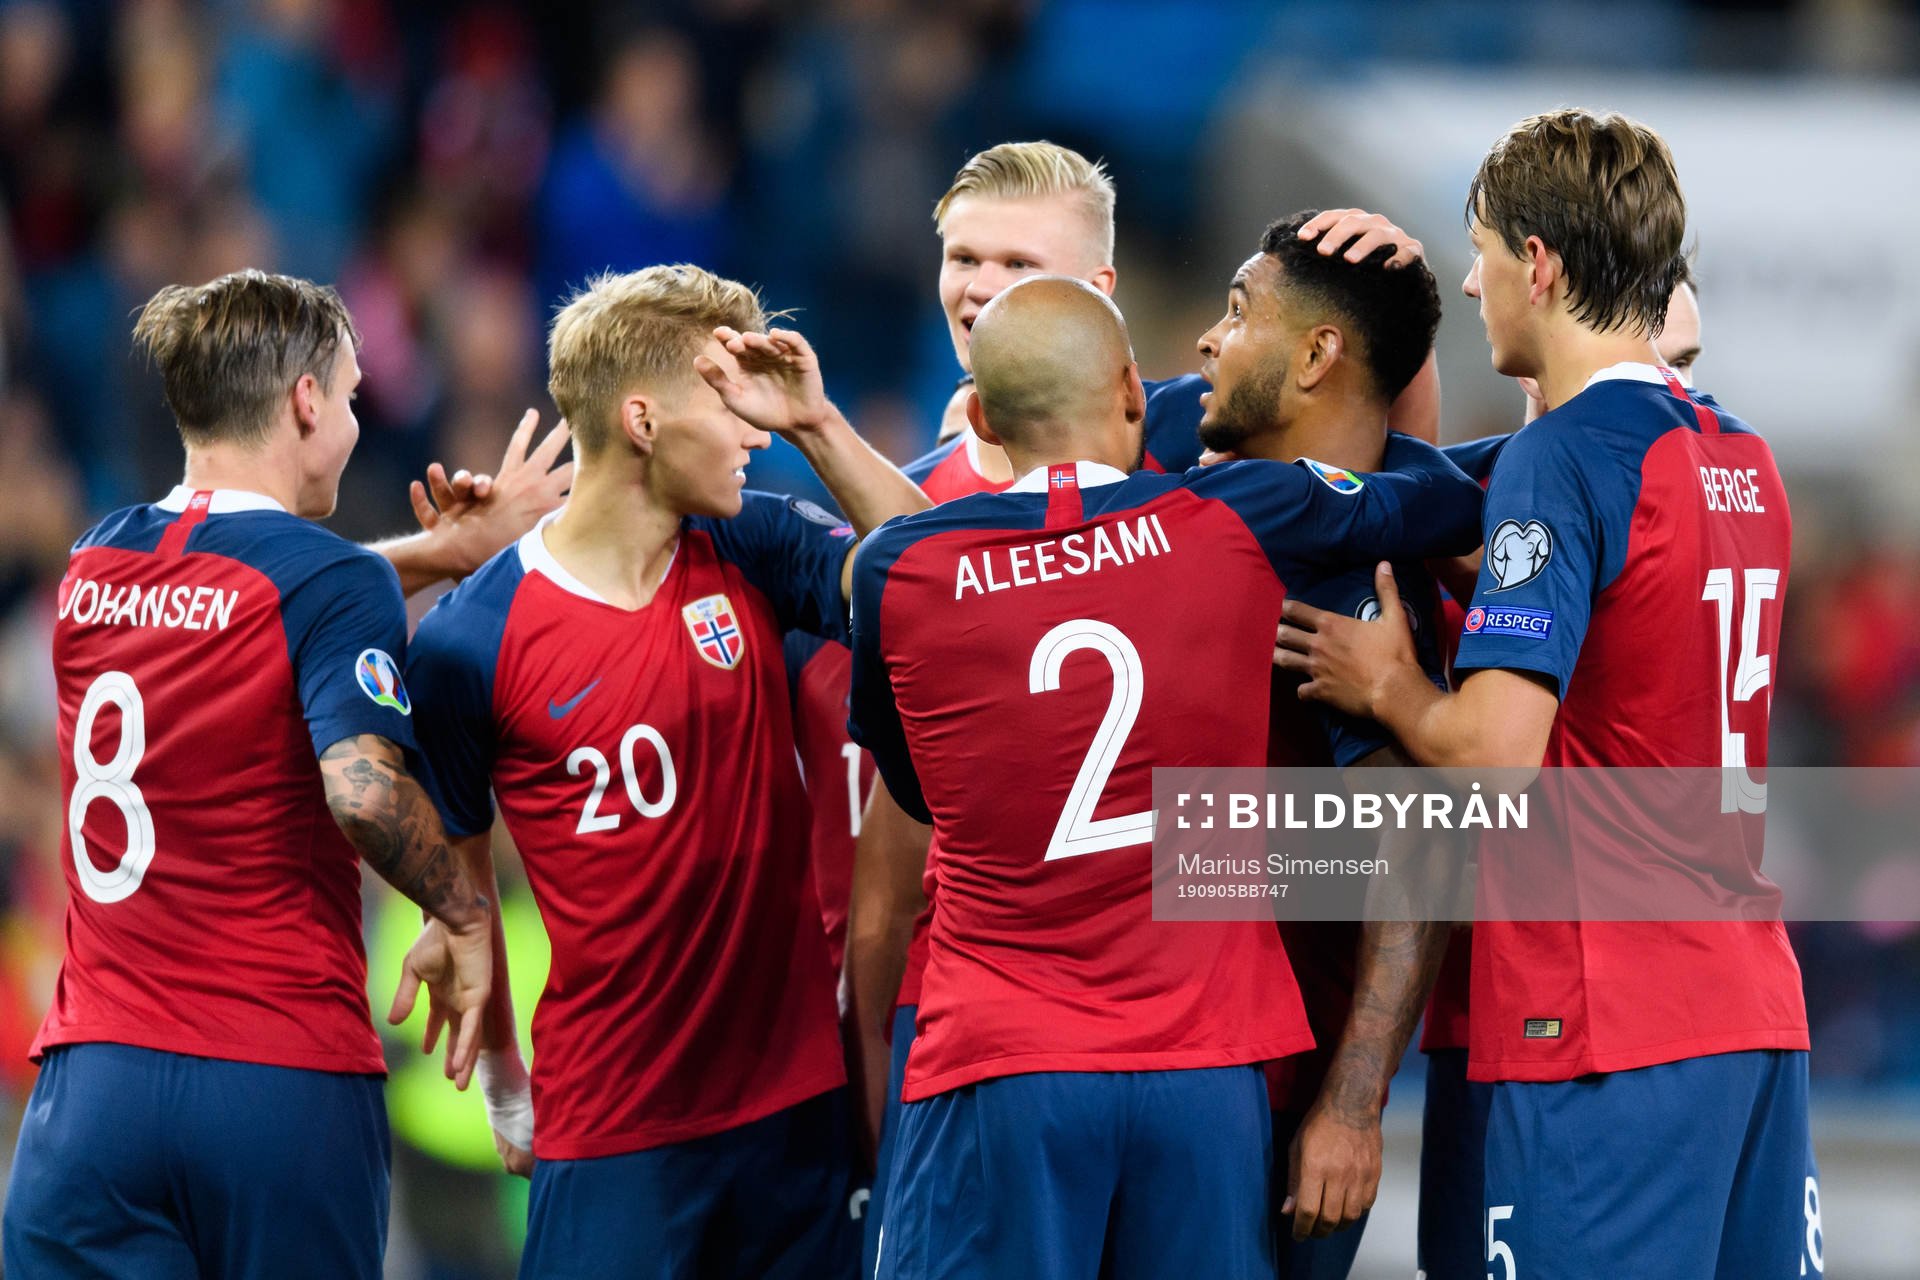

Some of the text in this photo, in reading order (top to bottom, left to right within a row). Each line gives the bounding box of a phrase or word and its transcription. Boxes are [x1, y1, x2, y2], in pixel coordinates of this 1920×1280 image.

[1700, 466, 1765, 513] BERGE
[58, 578, 239, 631] JOHANSEN
[955, 514, 1172, 601] ALEESAMI
[1486, 613, 1552, 632] RESPECT
[1029, 618, 1160, 863] 2
[1701, 568, 1780, 814] 15
[69, 671, 156, 904] 8
[566, 723, 677, 835] 20
[1800, 1176, 1824, 1276] 8
